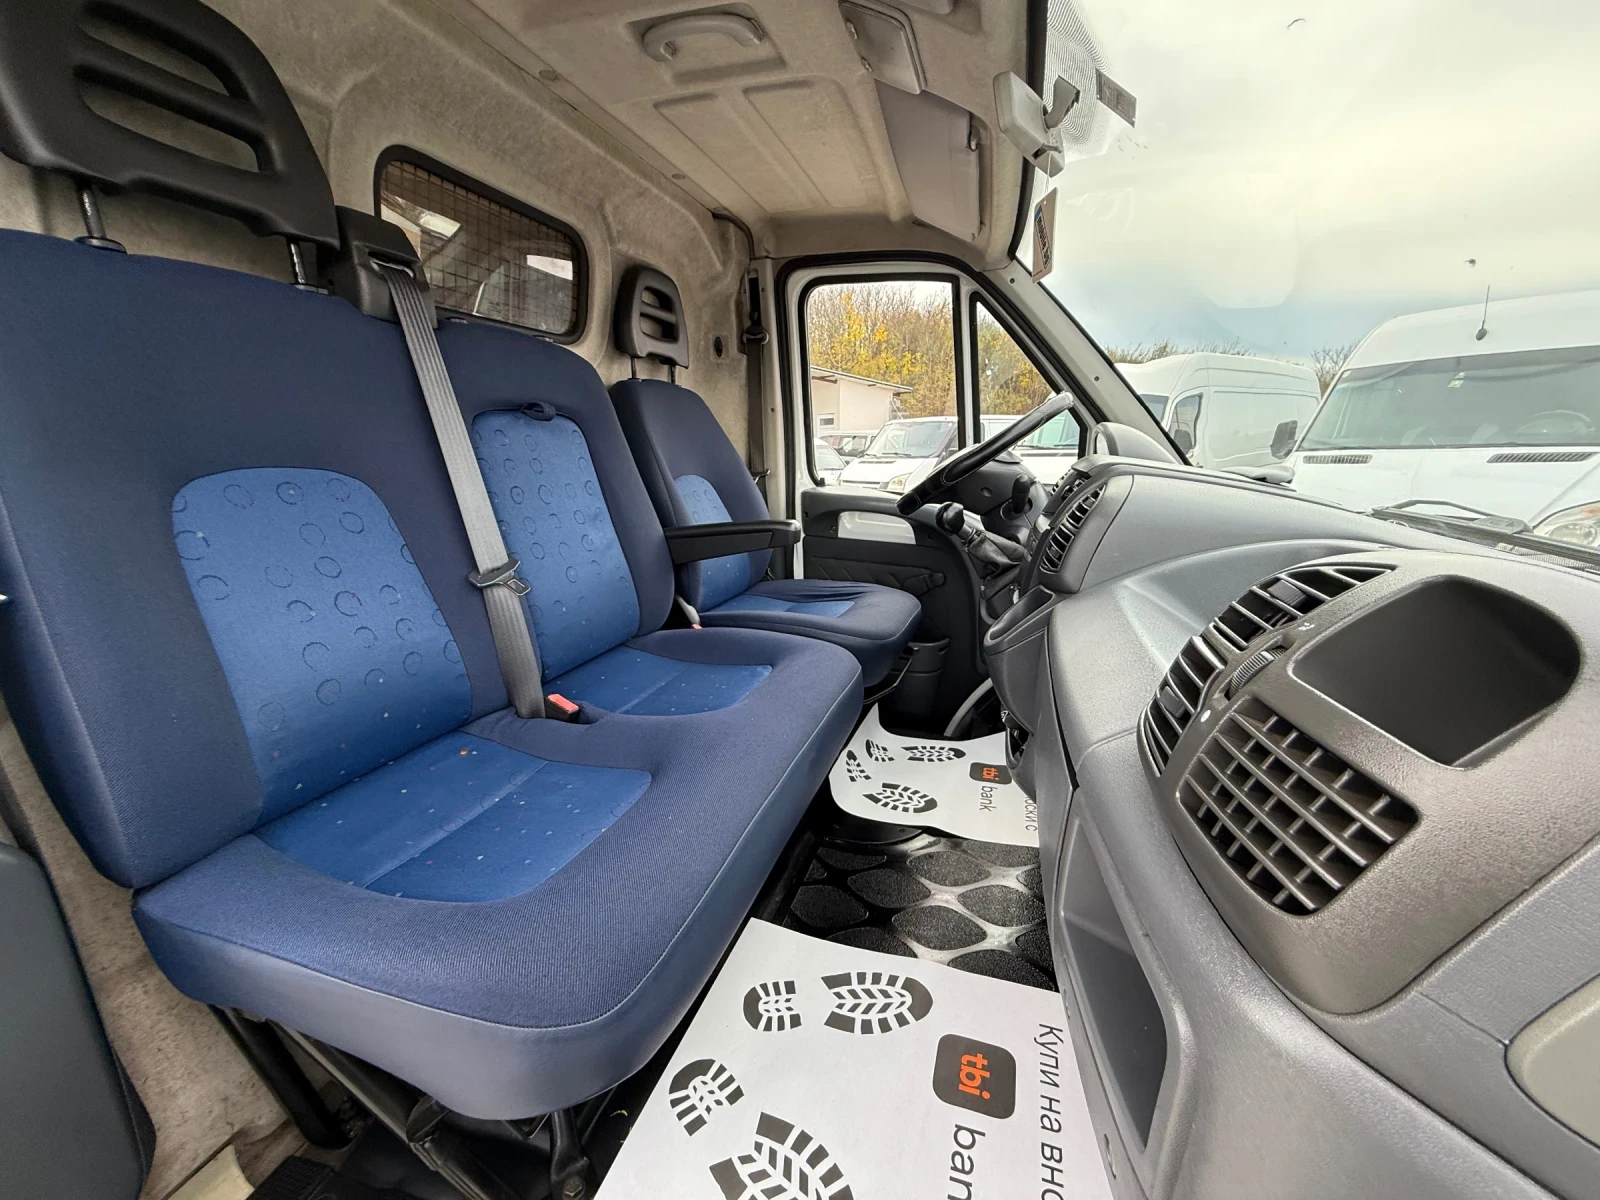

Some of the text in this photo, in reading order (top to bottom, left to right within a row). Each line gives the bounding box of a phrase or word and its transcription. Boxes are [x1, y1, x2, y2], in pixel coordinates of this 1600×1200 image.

[982, 767, 999, 780] tbi
[979, 785, 998, 812] bank
[1025, 796, 1037, 822] оски
[1034, 1023, 1064, 1088] Купи
[959, 1053, 990, 1099] tbi
[1040, 1094, 1062, 1134] на
